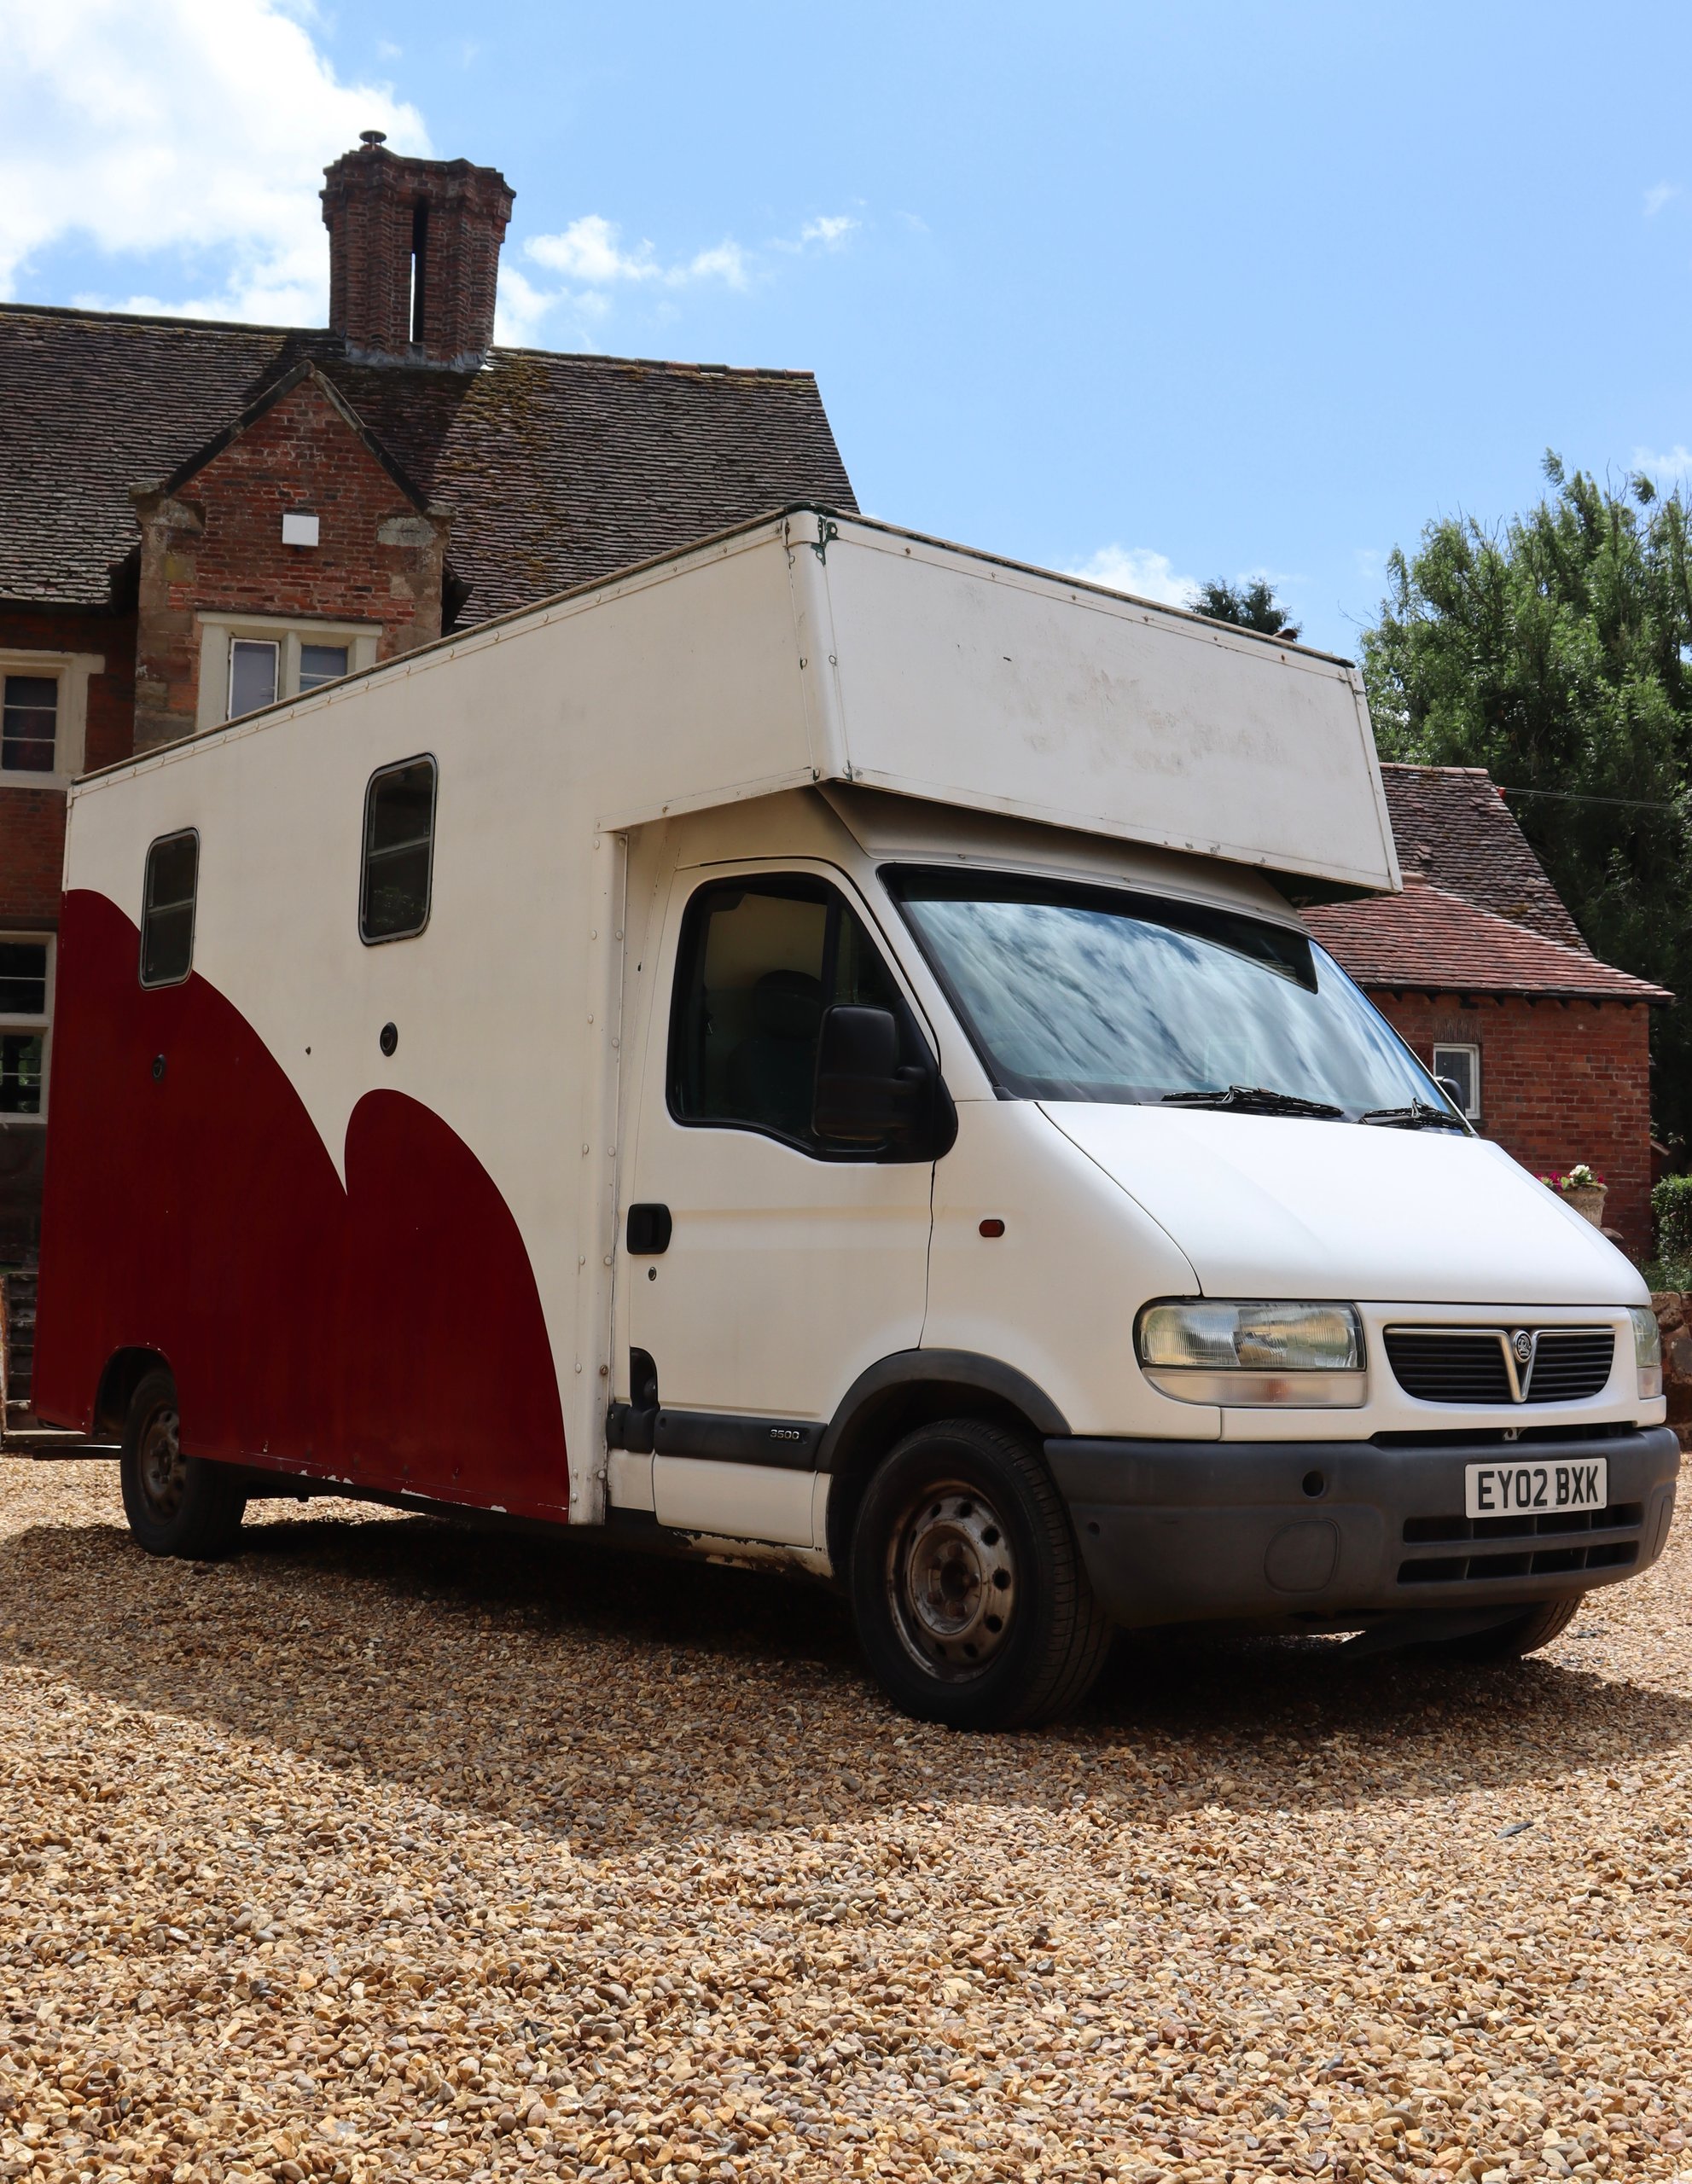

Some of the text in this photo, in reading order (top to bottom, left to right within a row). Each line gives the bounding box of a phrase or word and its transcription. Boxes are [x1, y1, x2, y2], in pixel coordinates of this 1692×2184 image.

[770, 1429, 799, 1440] 3500
[1478, 1466, 1598, 1510] EY02 BXK
